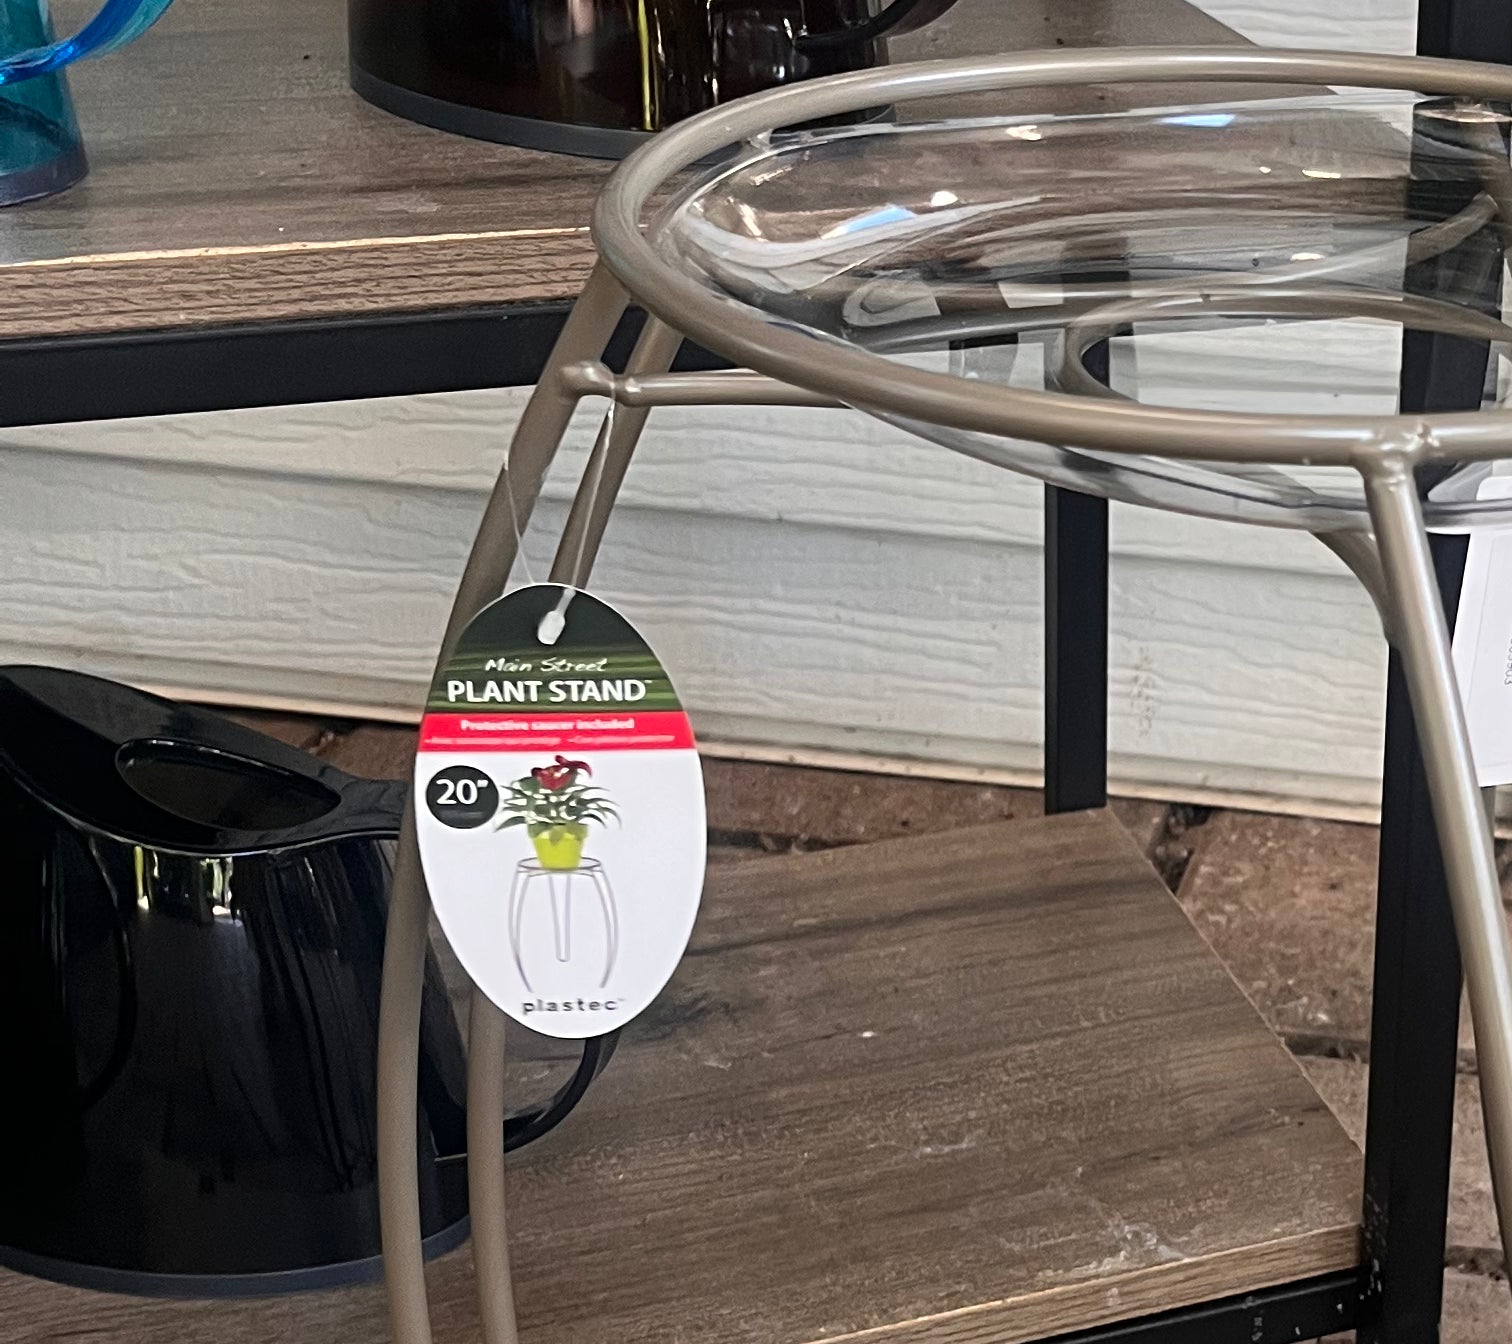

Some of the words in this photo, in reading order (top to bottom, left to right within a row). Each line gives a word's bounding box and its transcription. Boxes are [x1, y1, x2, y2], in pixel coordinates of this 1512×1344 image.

[485, 658, 532, 672] Main
[540, 657, 608, 672] Street
[447, 680, 543, 703] PLANT
[522, 998, 618, 1015] plastec
